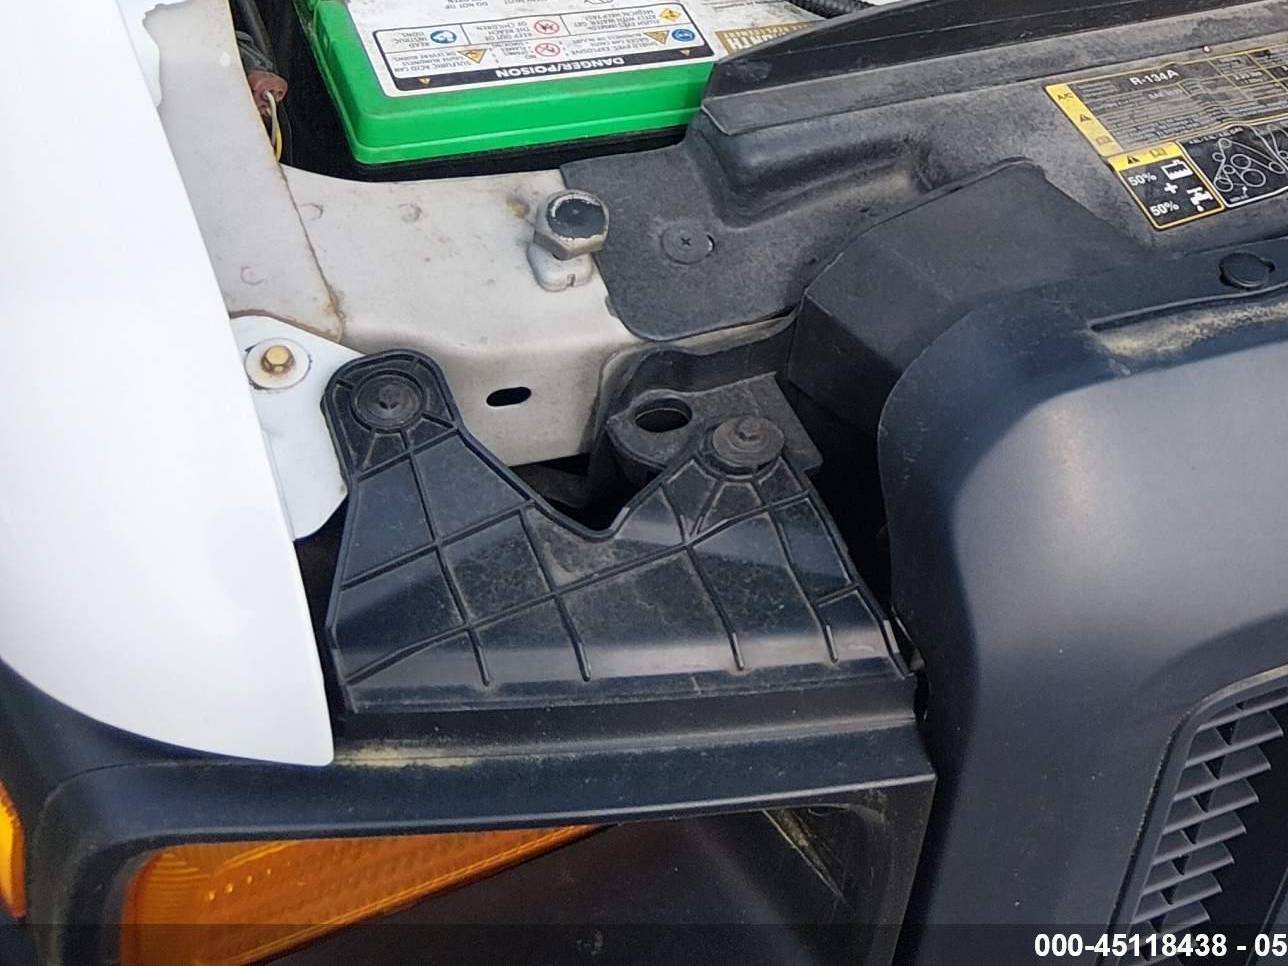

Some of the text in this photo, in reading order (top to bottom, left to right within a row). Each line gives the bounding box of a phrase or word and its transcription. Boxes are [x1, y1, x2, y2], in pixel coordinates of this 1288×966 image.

[494, 56, 624, 78] DANGER/POISON
[1129, 68, 1179, 86] R-134A
[1128, 171, 1157, 187] 50%
[1150, 200, 1180, 217] 50%
